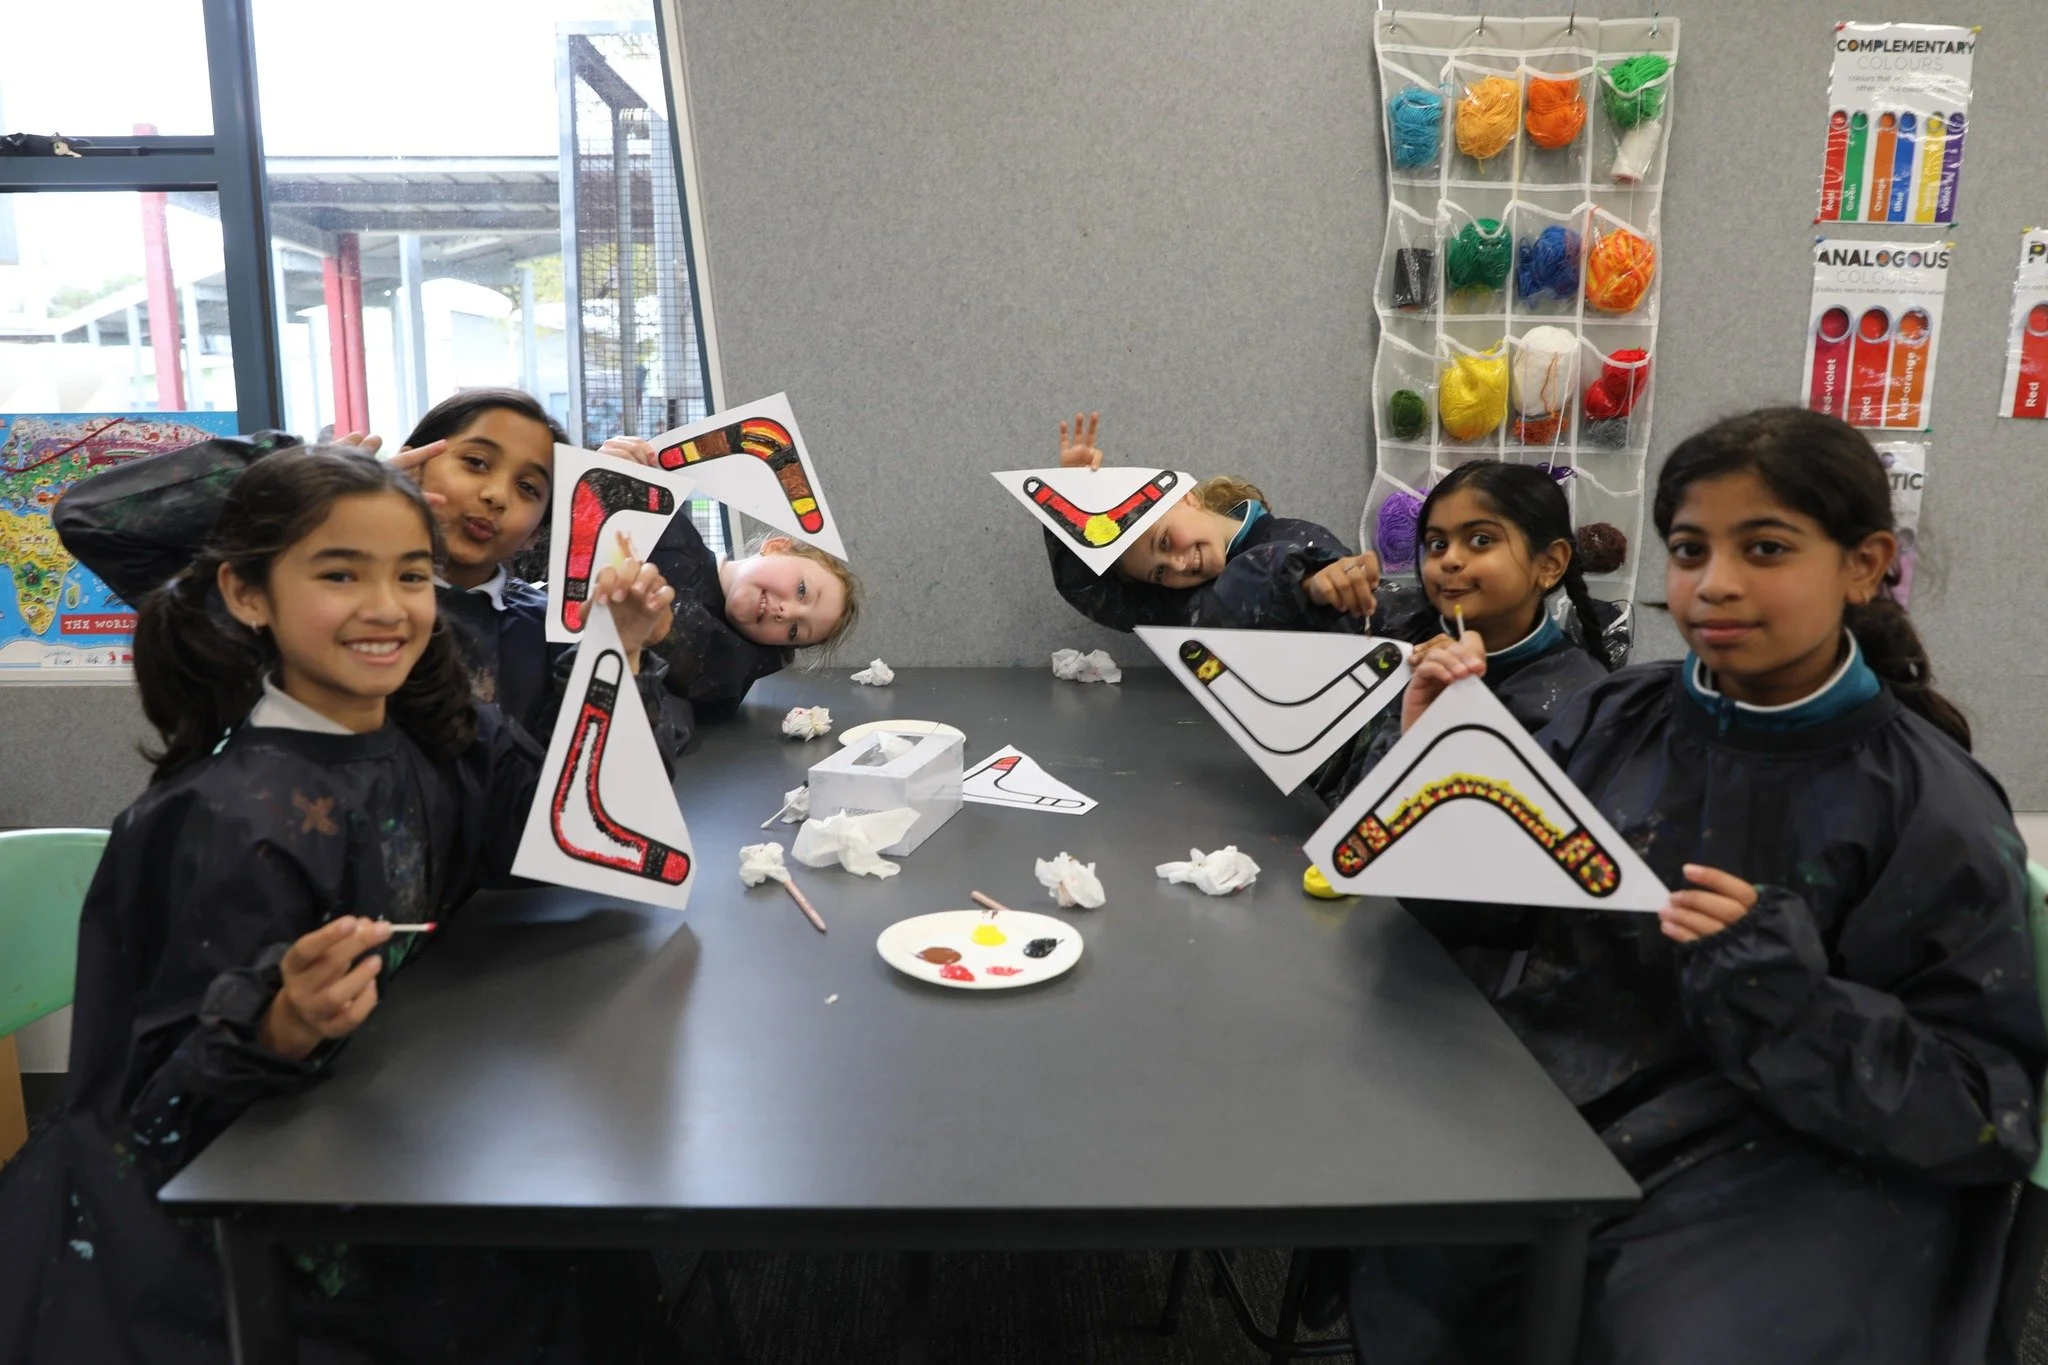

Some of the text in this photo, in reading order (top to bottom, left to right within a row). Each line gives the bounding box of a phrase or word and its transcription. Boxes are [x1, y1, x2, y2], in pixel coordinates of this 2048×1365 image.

[1836, 39, 1976, 54] COMPLEMENTARY
[1857, 56, 1944, 71] COLOURS
[1825, 189, 1836, 211] Red
[1845, 183, 1857, 212] Green
[1873, 177, 1887, 212] Orange
[1892, 191, 1905, 213] Blue
[1940, 186, 1953, 214] Violet
[1817, 249, 1950, 269] ANALOGOUS
[1898, 352, 1918, 420] Red-orange
[2025, 382, 2040, 407] Red
[1861, 396, 1872, 420] Red
[1891, 473, 1924, 491] TIC
[64, 618, 137, 630] THE WORLD
